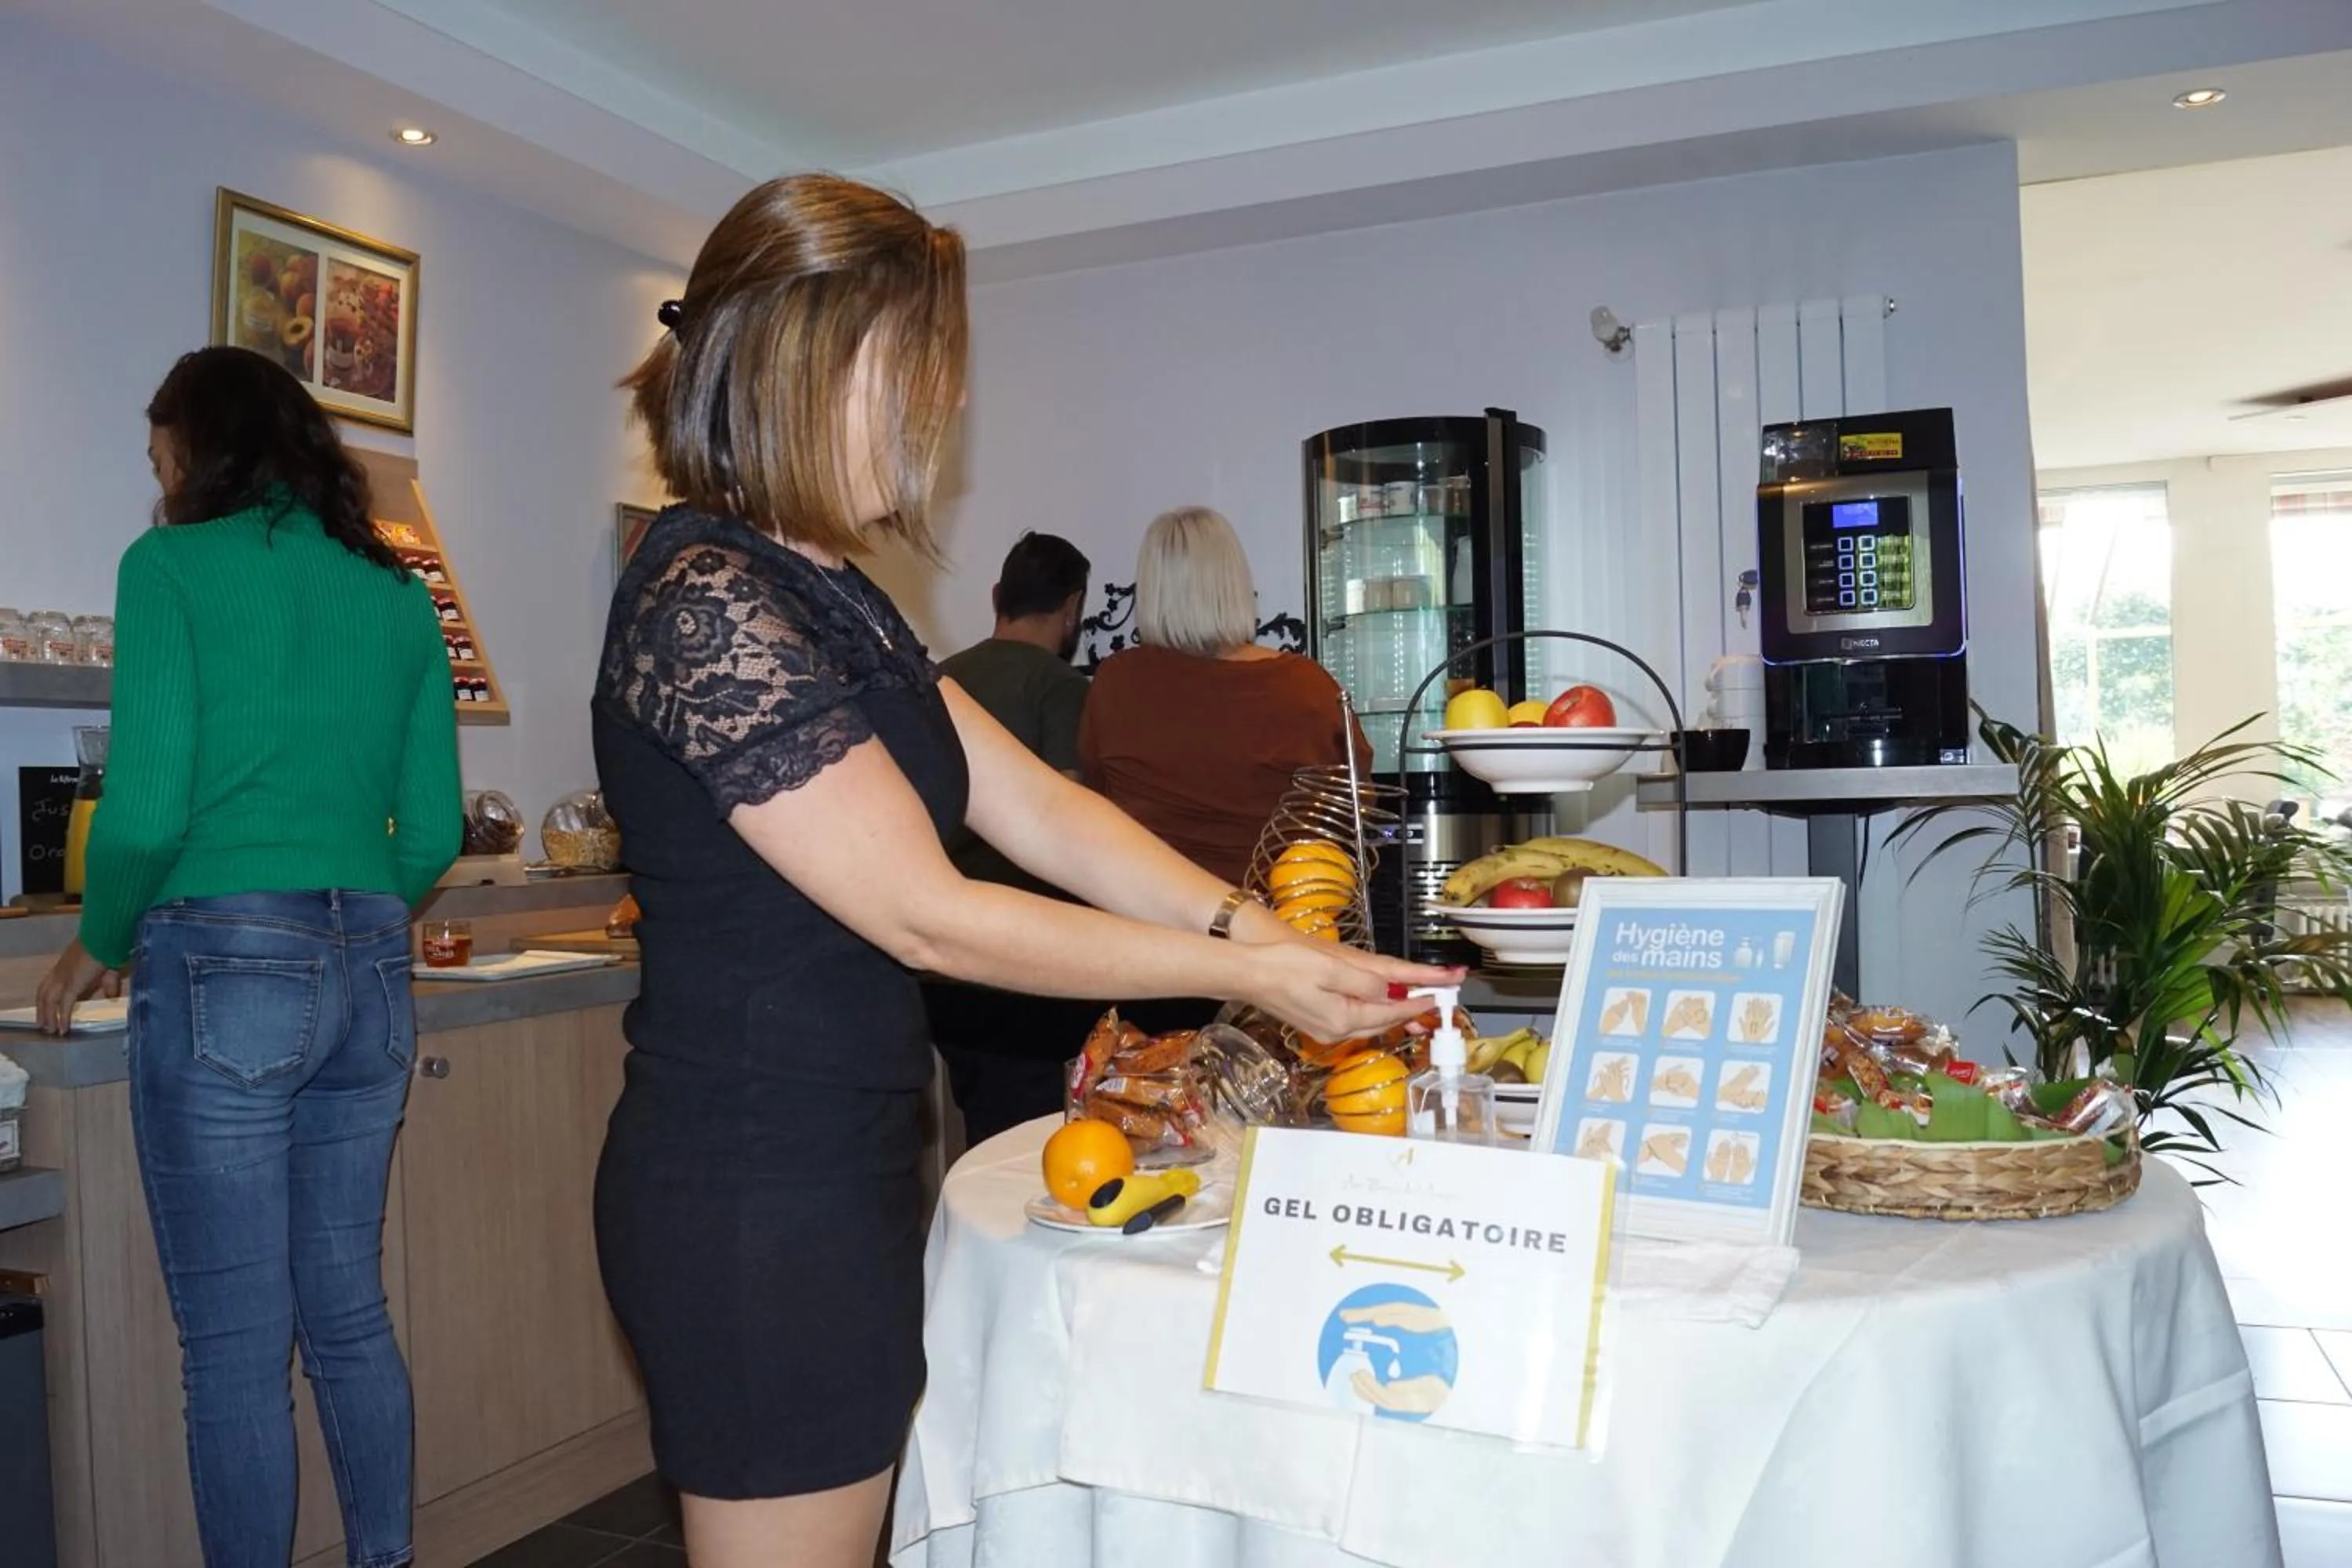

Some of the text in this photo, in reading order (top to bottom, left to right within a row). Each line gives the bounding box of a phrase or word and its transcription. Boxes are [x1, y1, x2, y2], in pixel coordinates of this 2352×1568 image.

[1615, 921, 1725, 951] Hygiène
[1612, 945, 1722, 969] des mains
[1263, 1196, 1567, 1254] GEL OBLIGATOIRE
